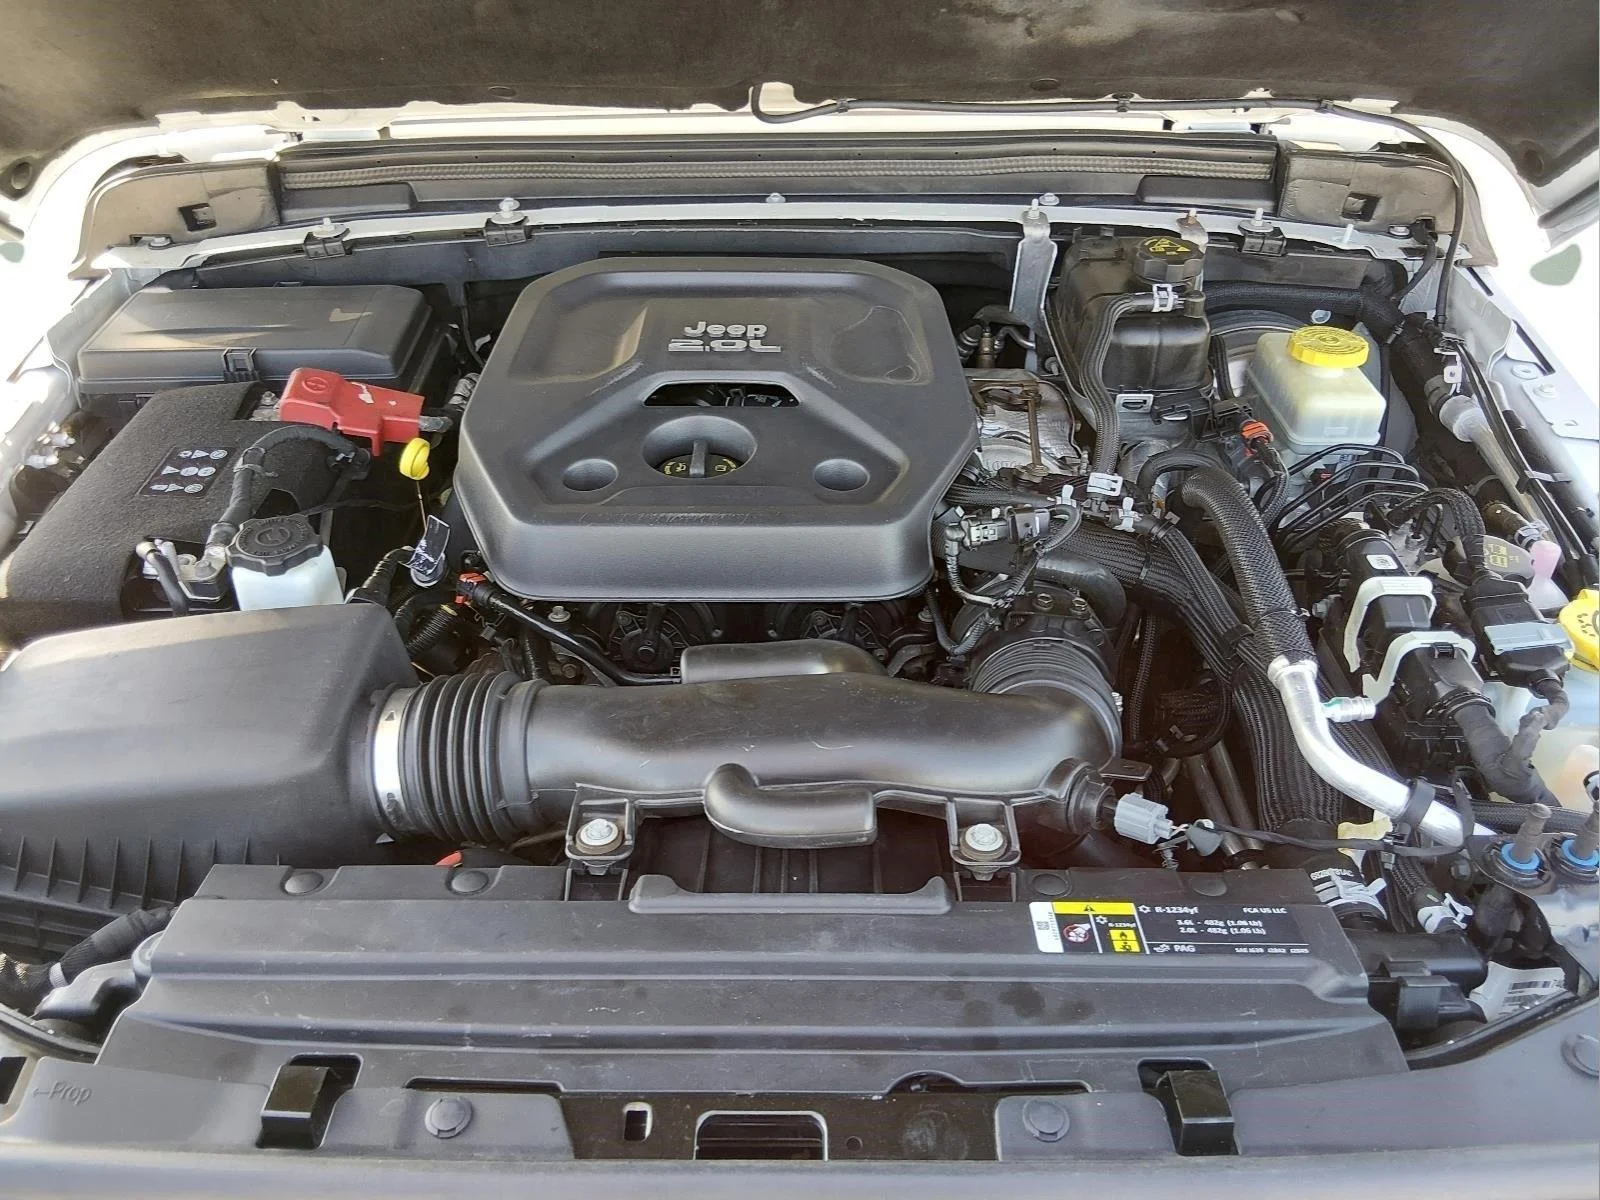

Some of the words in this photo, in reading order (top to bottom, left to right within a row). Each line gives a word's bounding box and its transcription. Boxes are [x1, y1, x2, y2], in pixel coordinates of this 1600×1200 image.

[684, 321, 768, 339] Jeep
[668, 339, 781, 353] 2.0L
[1154, 906, 1199, 914] R-1234yf
[1173, 944, 1197, 952] PAG
[48, 1080, 93, 1107] Prop
